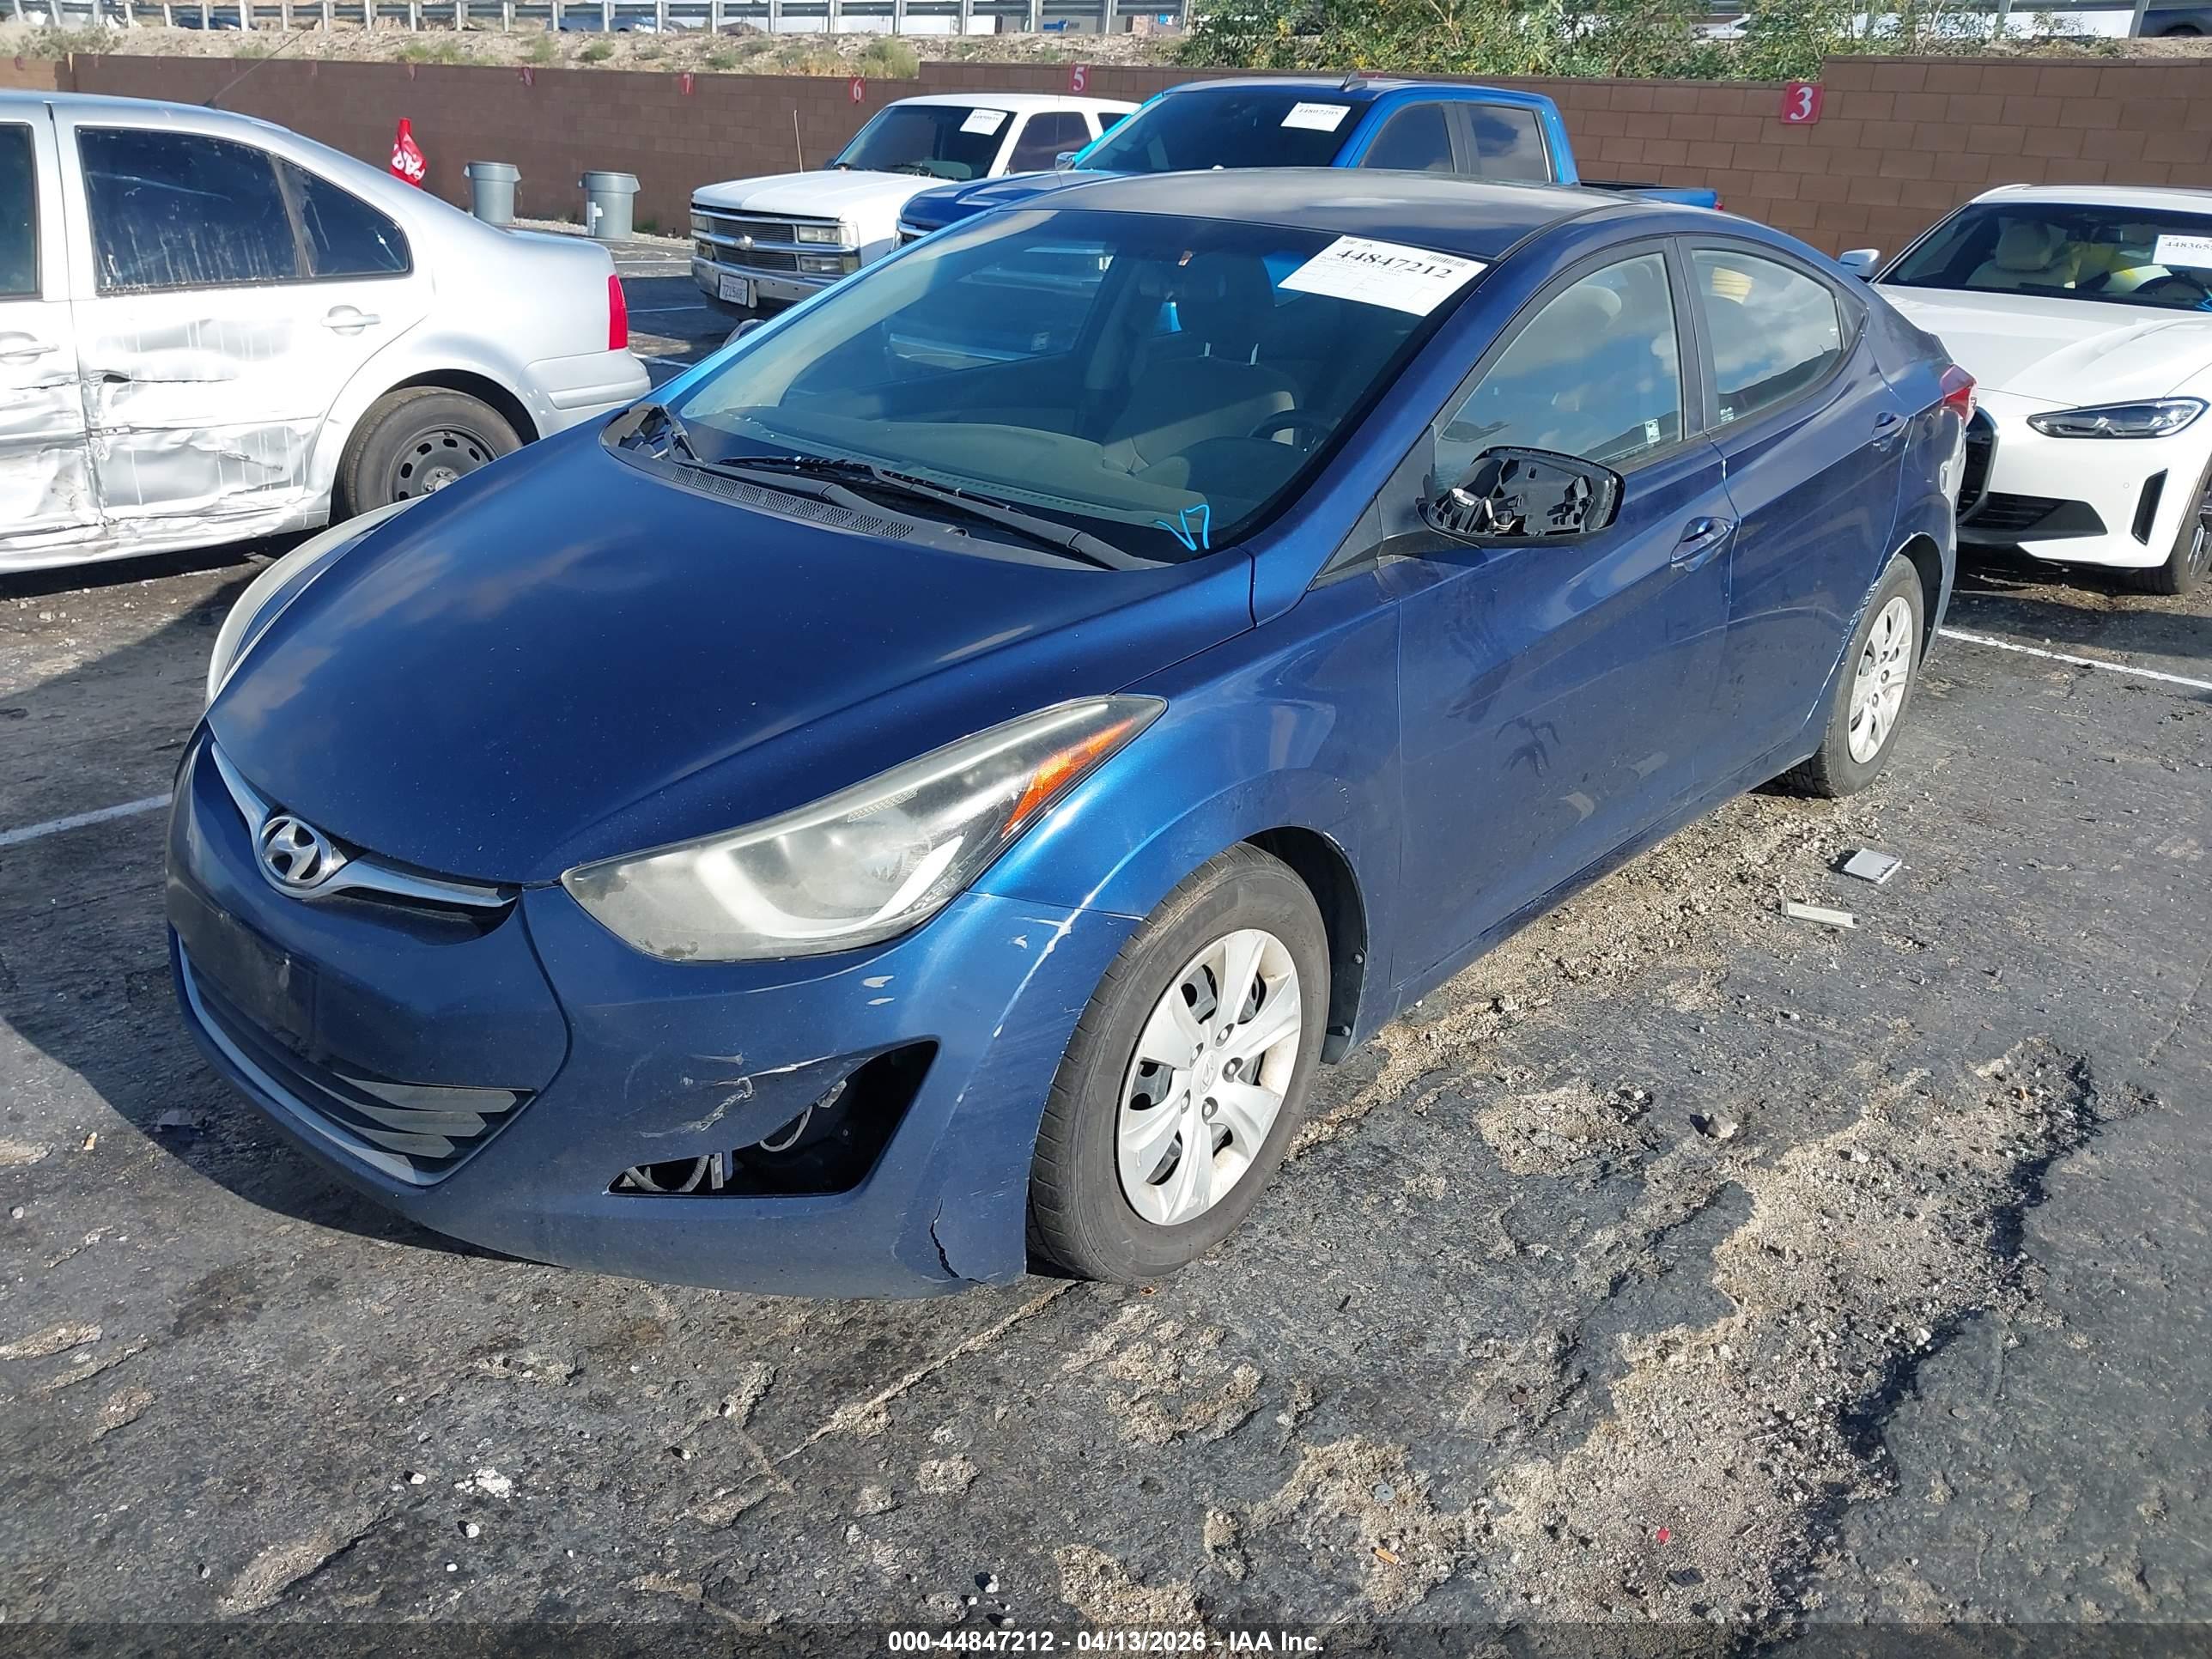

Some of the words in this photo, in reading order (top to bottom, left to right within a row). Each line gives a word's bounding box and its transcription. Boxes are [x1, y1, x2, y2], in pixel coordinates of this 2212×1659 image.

[684, 74, 690, 94] 7
[854, 78, 862, 100] 6
[1073, 67, 1085, 91] 5
[1790, 87, 1813, 120] 3
[2165, 241, 2212, 250] 448365
[1336, 249, 1453, 279] 44847212
